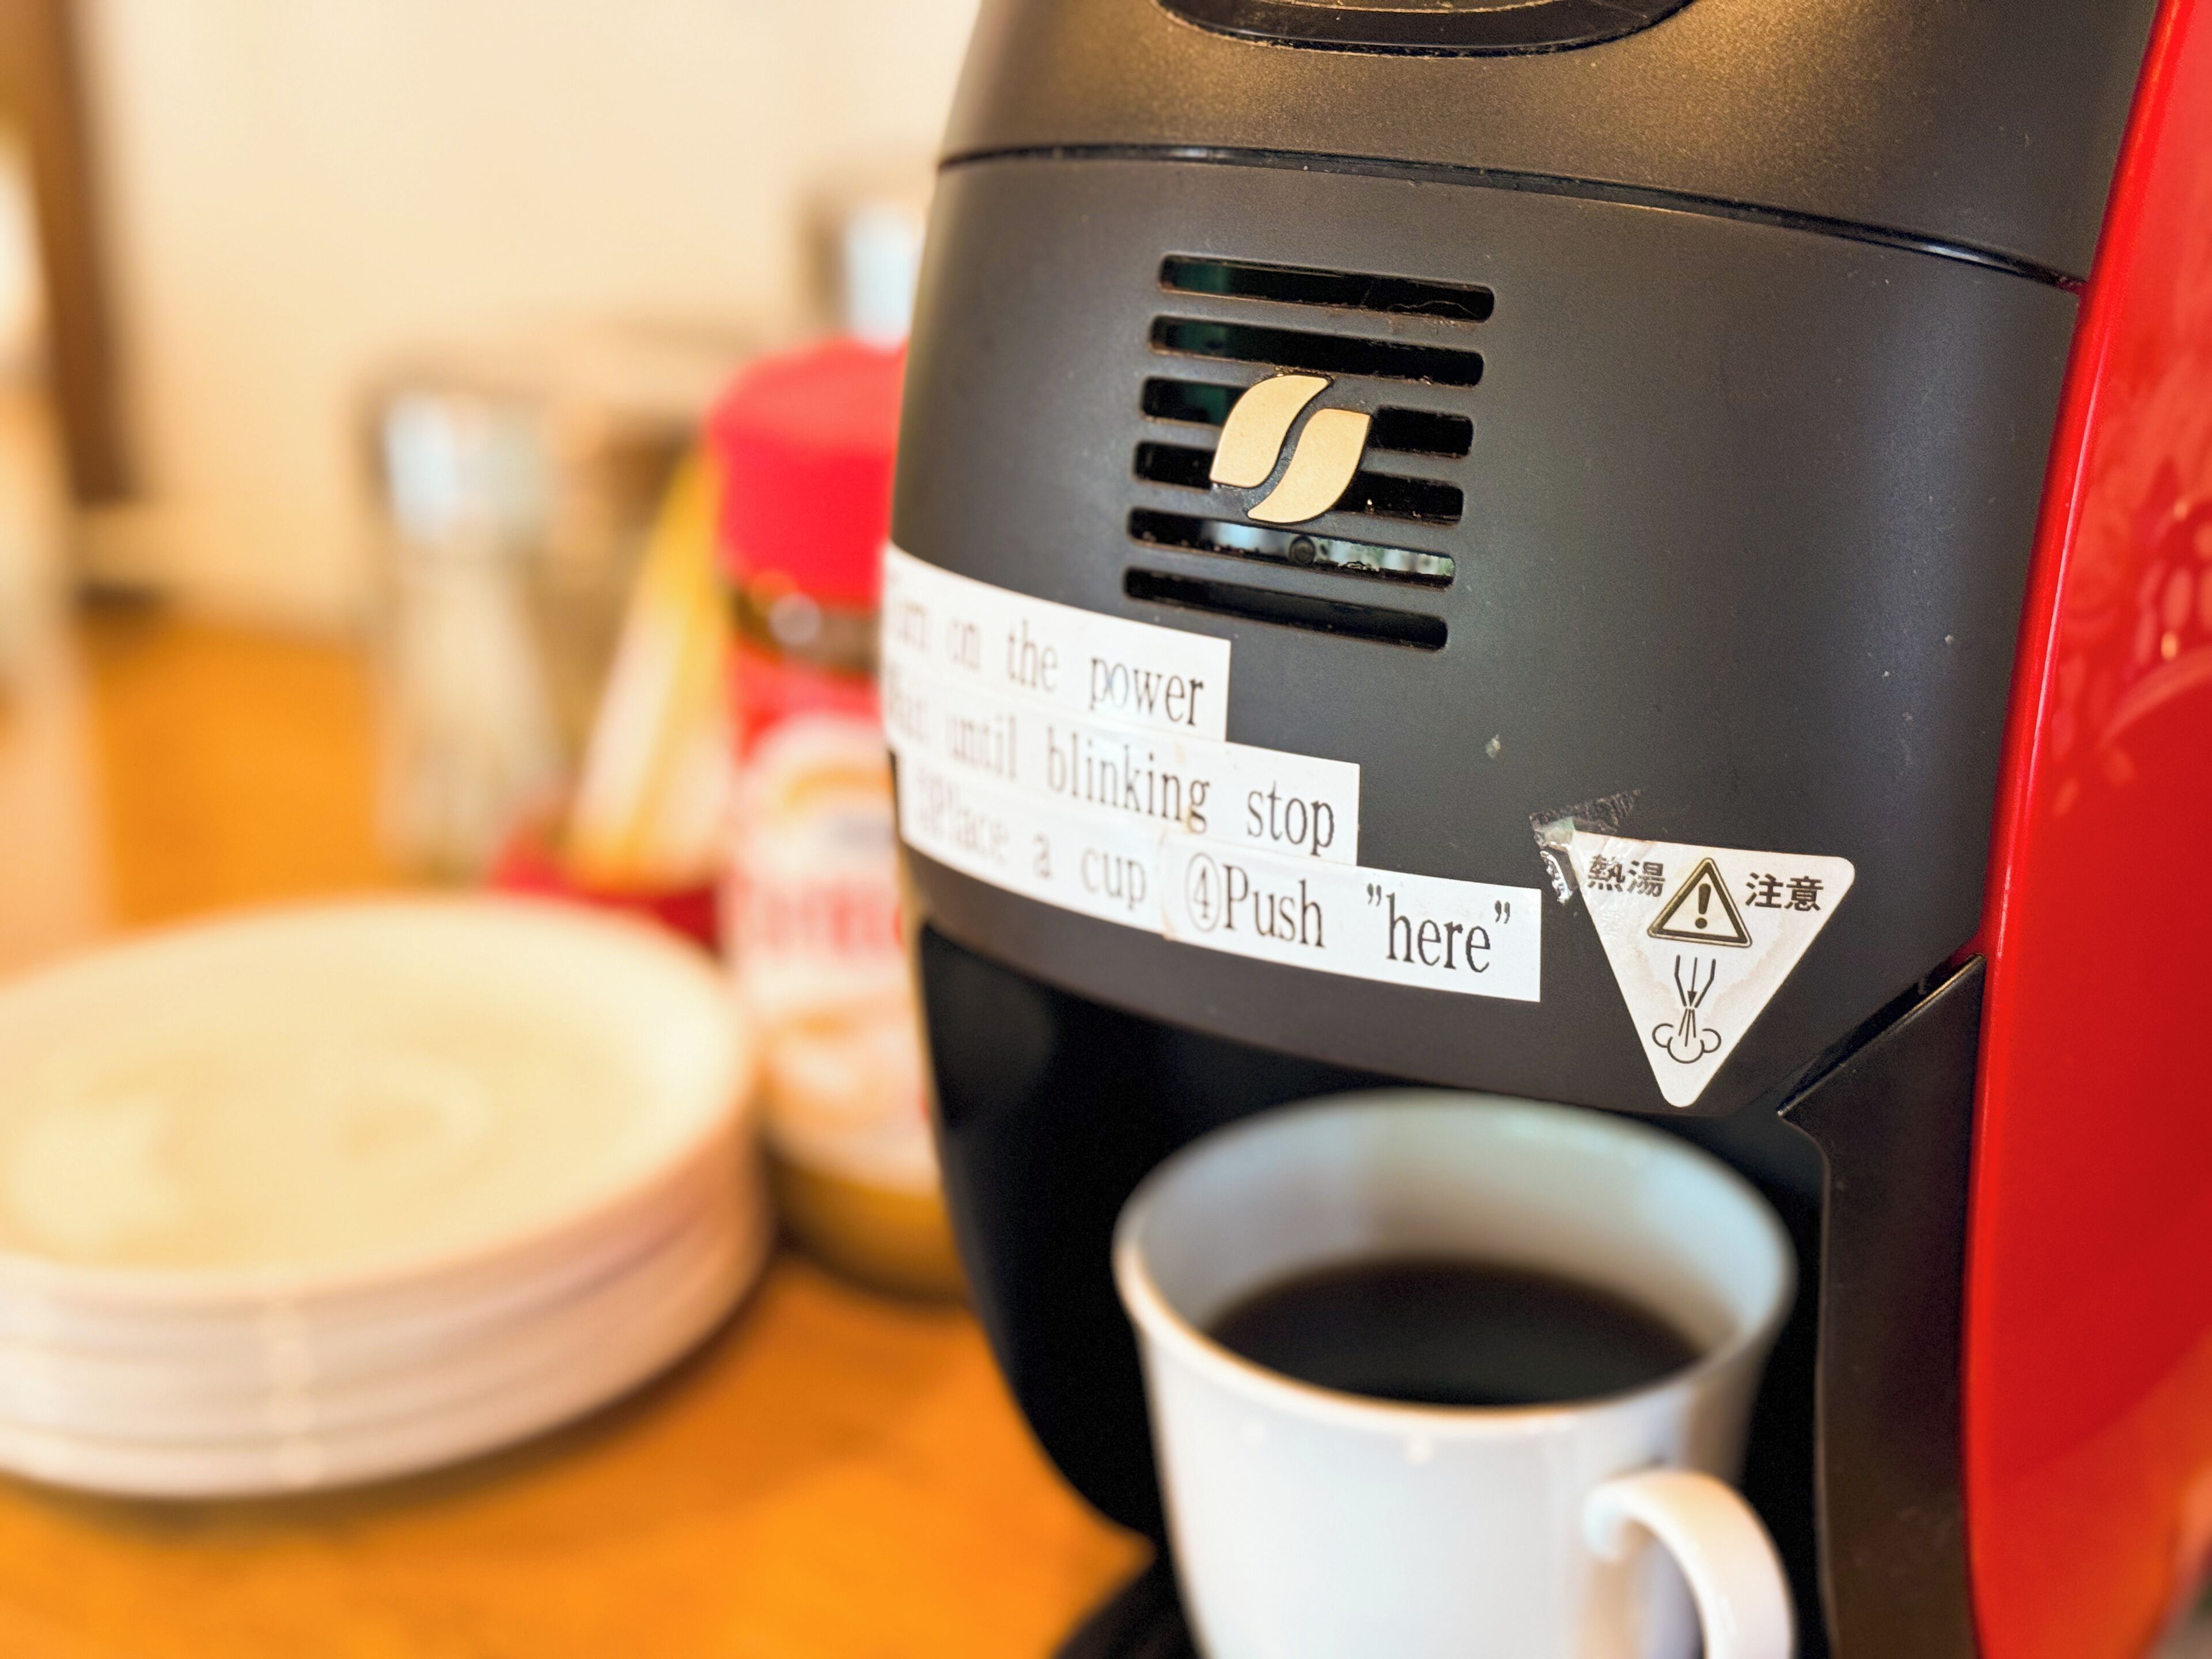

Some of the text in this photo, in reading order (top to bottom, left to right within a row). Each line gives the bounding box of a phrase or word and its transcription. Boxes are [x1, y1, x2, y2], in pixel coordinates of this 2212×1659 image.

[1007, 618, 1058, 692] the
[1090, 657, 1205, 726] power
[946, 714, 1017, 781] until
[1047, 726, 1211, 834] blinking
[1247, 779, 1335, 856] stop
[1033, 832, 1052, 879] a
[1081, 847, 1146, 910] cup
[1588, 854, 1824, 911] 熱湯 注意
